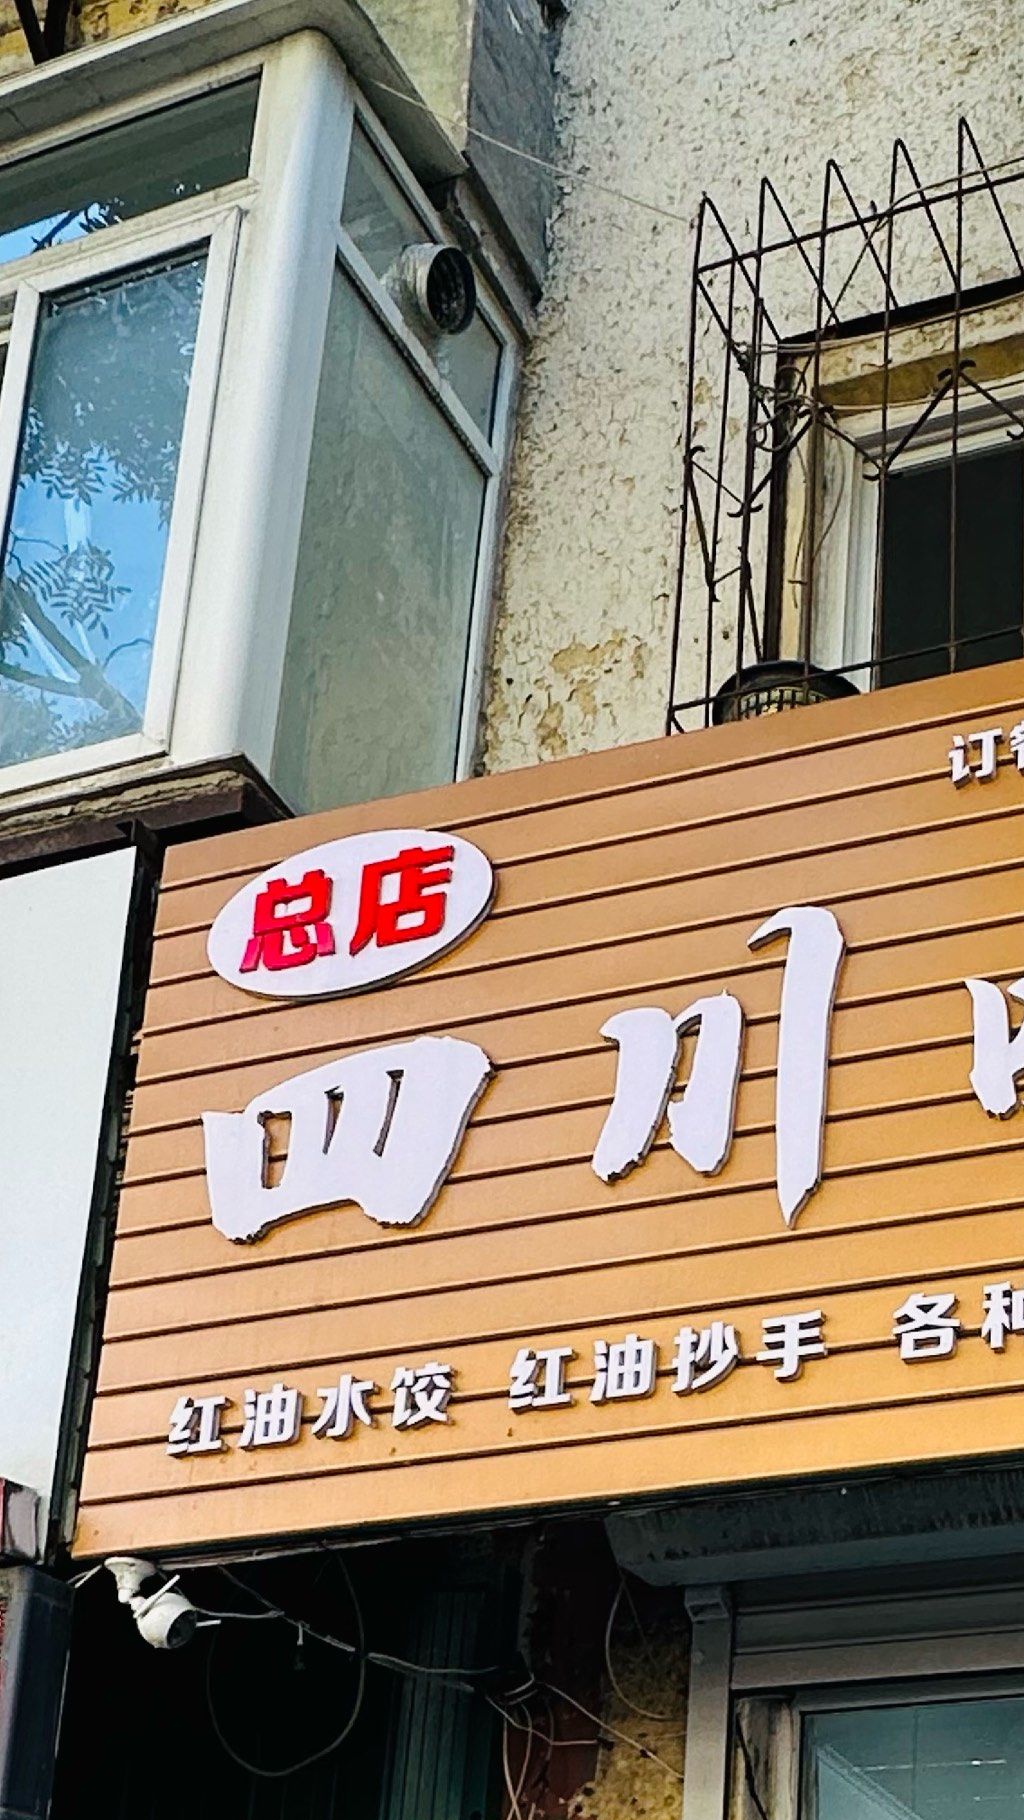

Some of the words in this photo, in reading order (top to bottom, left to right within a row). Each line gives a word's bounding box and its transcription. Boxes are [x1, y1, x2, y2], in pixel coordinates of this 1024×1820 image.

[240, 845, 457, 972] 总店
[166, 1362, 454, 1457] 红油水饺
[508, 1309, 827, 1411] 红油抄手
